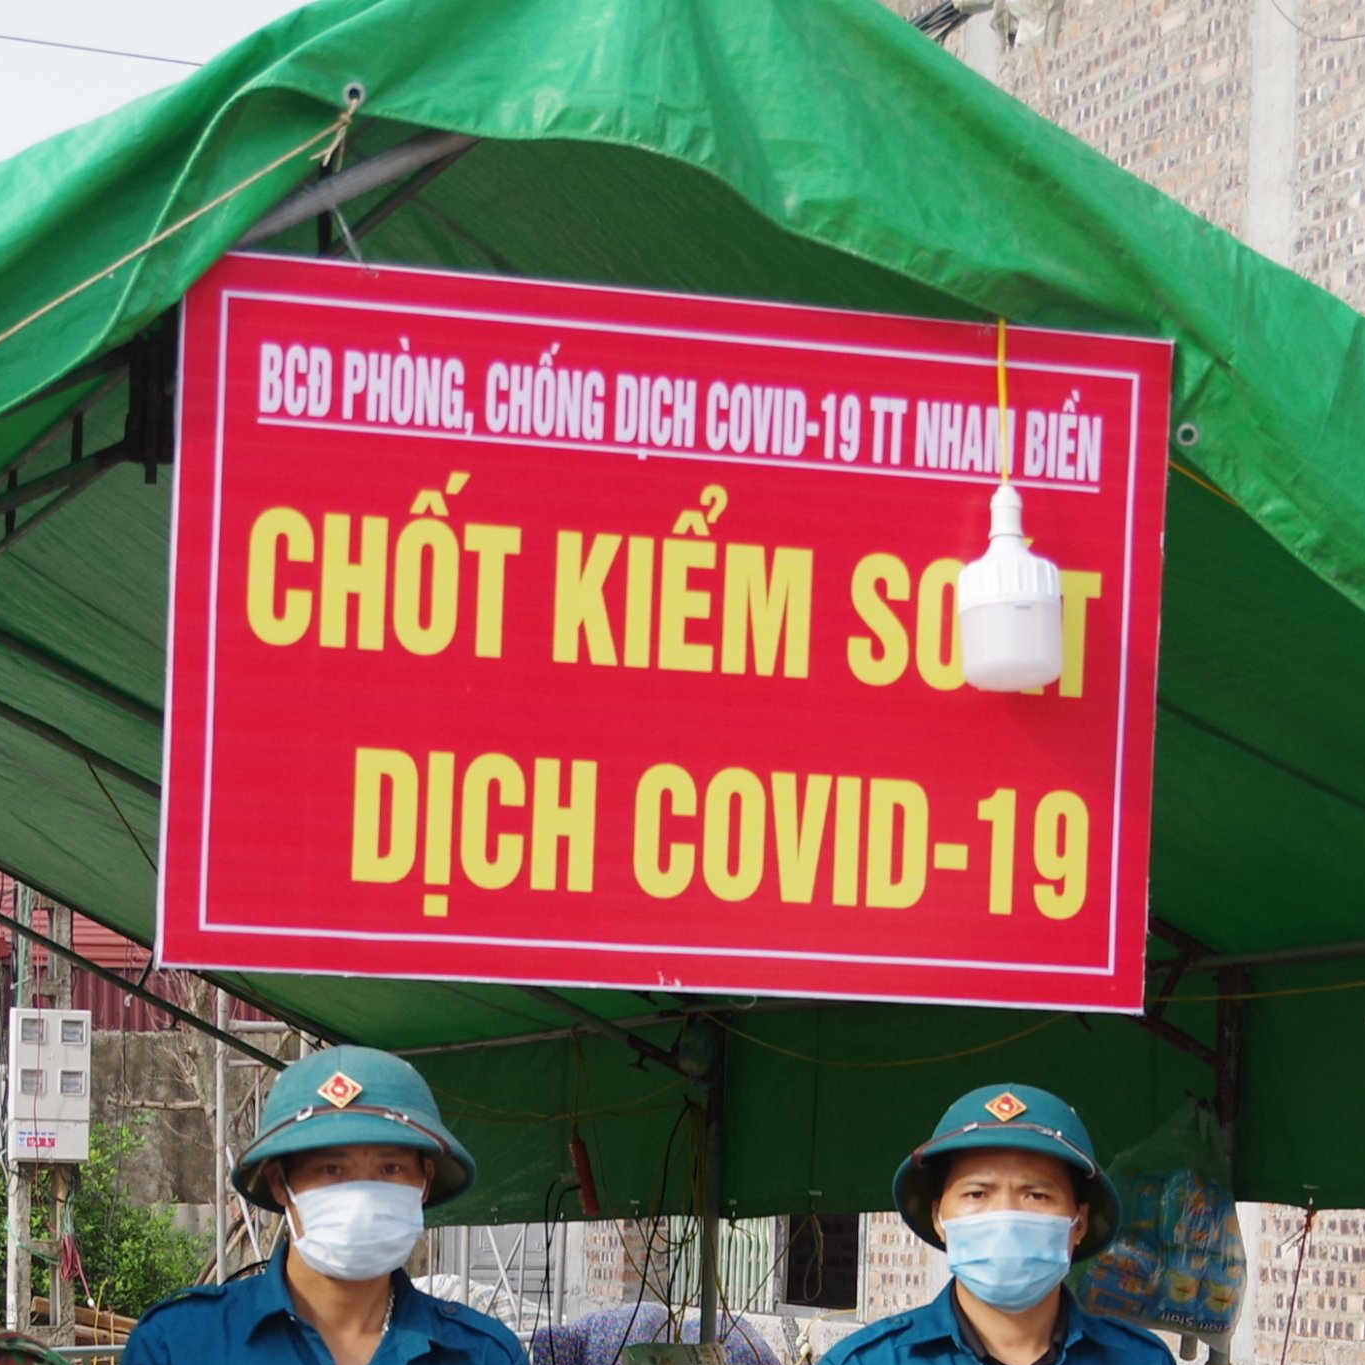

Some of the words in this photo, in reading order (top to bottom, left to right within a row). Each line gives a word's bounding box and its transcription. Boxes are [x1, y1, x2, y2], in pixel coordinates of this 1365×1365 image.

[259, 343, 333, 418] BCĐ
[342, 336, 474, 436] PHÒNG,
[485, 343, 605, 441] CHỐNG
[615, 372, 696, 460] DỊCH
[706, 381, 861, 463] COVID-19
[870, 396, 908, 466] TT
[915, 401, 1015, 475] NHAM
[1024, 389, 1102, 483] BIỀN
[246, 472, 523, 659] CHỐT
[553, 484, 814, 680] KIỂM
[847, 538, 1102, 698] SOT
[351, 747, 598, 918] DỊCH
[634, 763, 1090, 921] COVID-19
